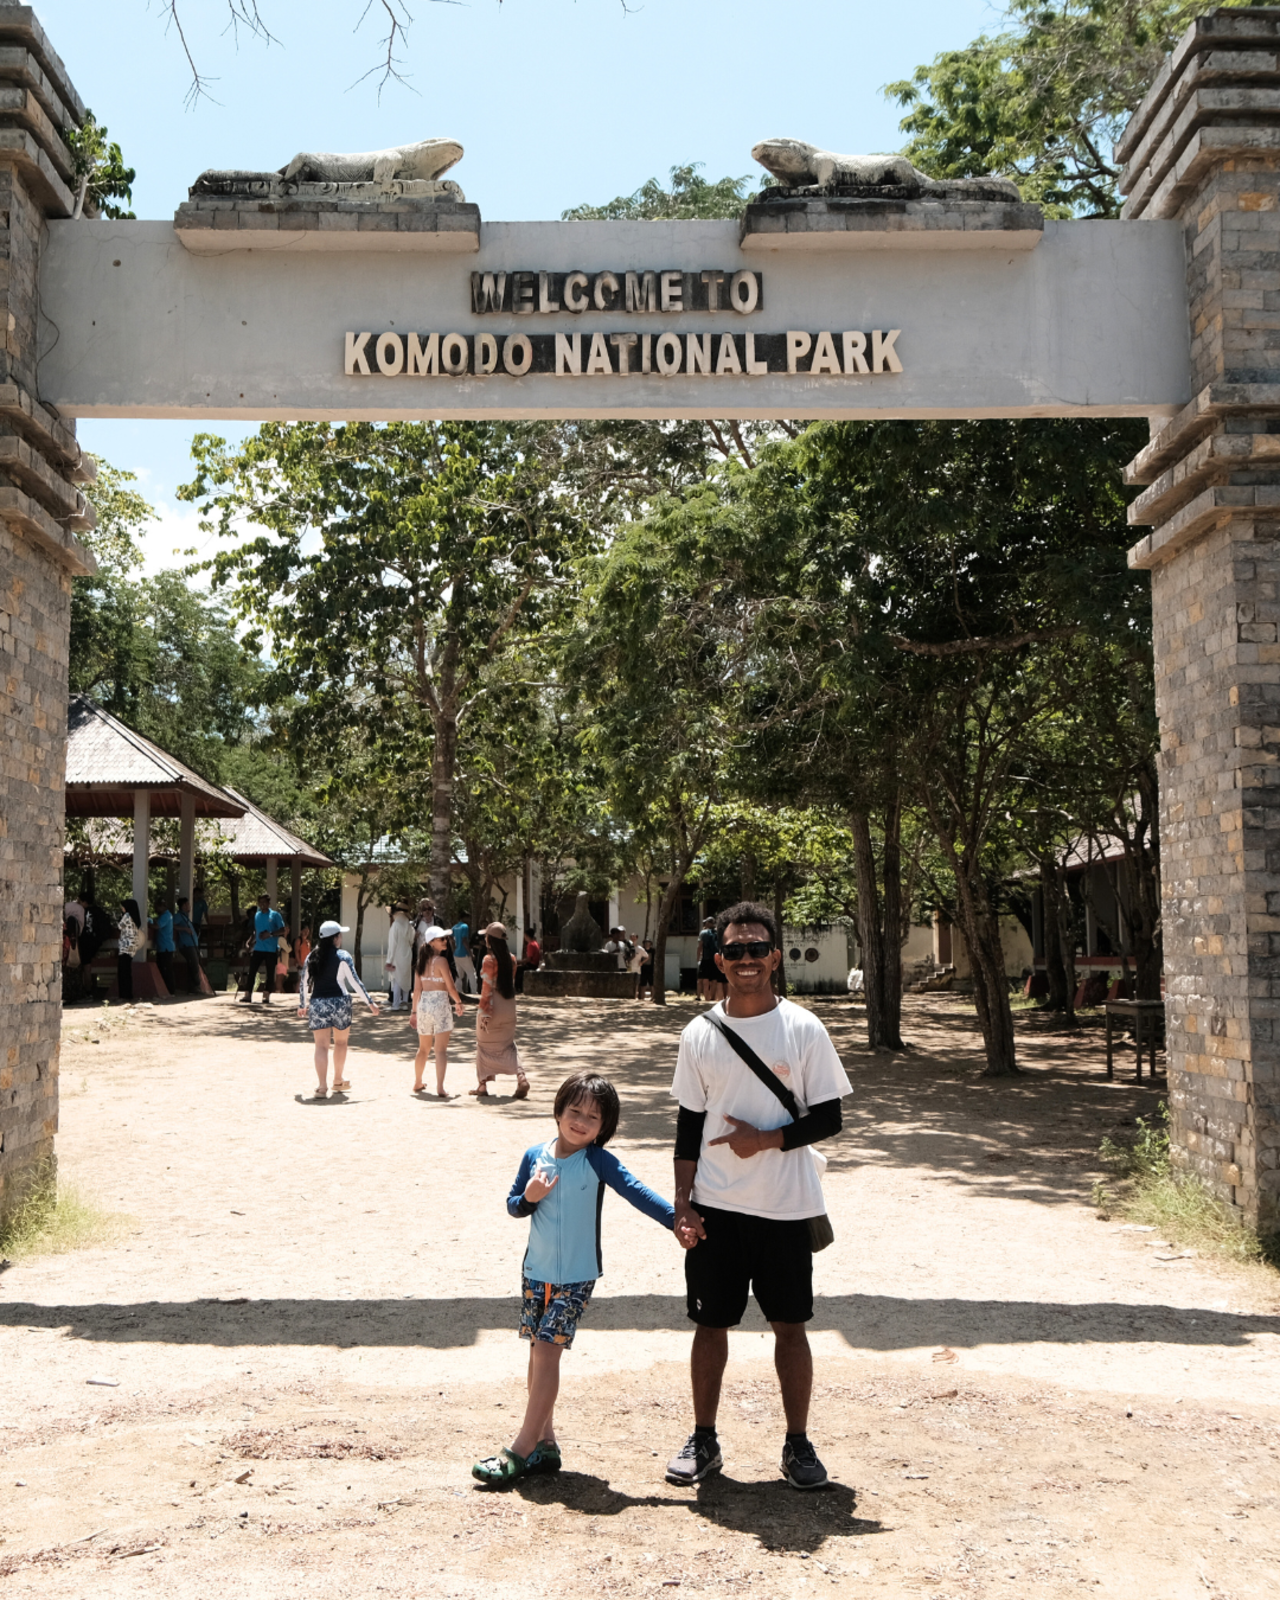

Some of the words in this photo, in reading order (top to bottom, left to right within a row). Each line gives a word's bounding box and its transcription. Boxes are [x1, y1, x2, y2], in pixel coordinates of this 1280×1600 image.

[471, 270, 683, 314] WELCOME
[701, 269, 759, 314] TO
[345, 331, 533, 377] KOMODO
[555, 332, 768, 376] NATIONAL
[786, 329, 903, 375] PARK
